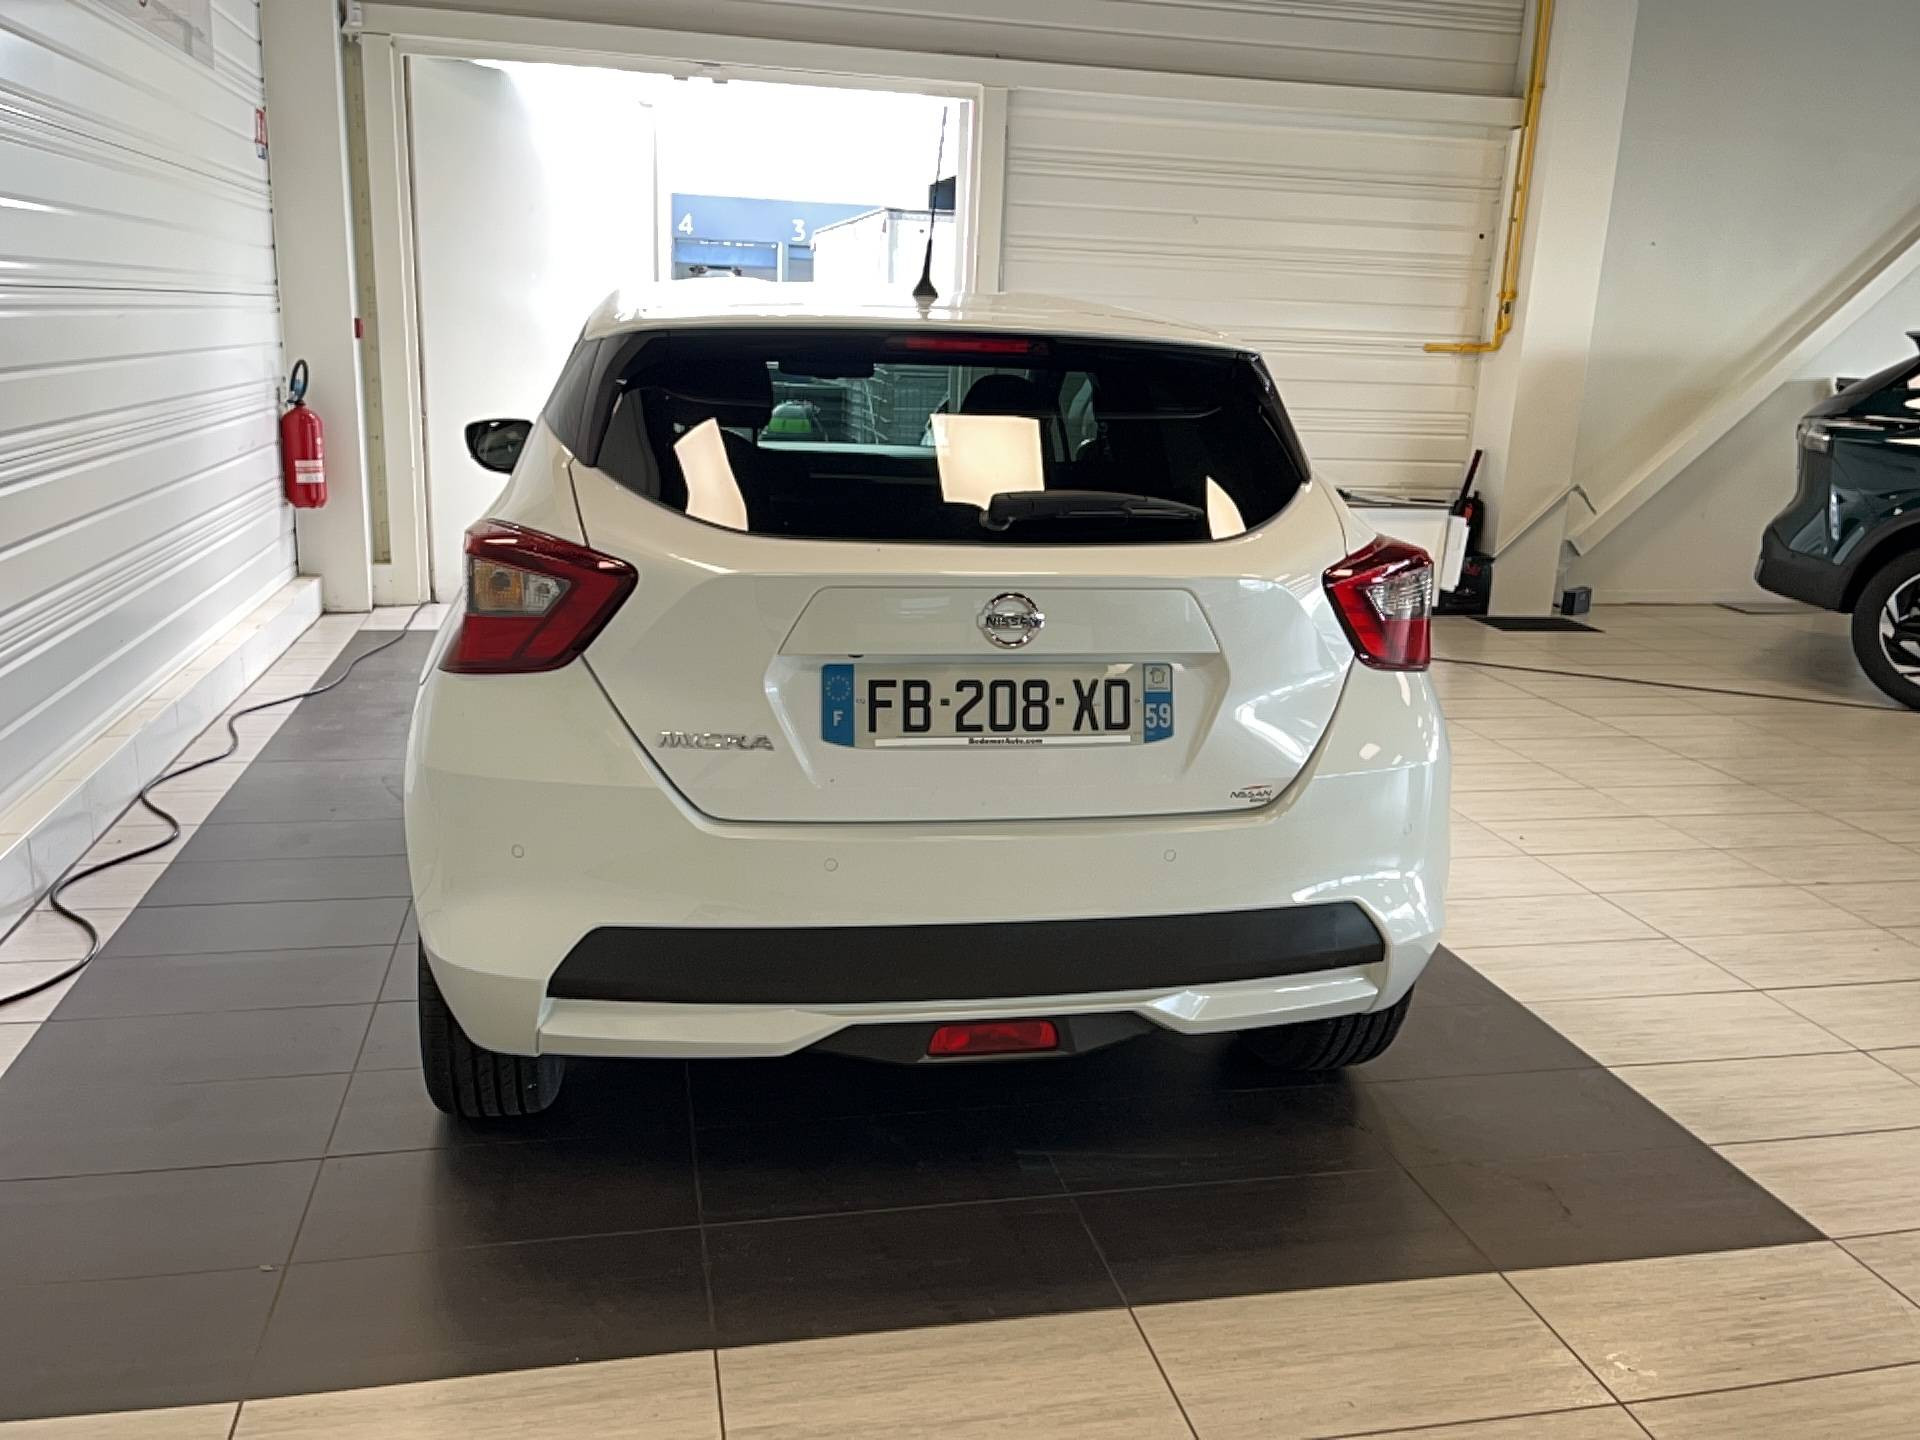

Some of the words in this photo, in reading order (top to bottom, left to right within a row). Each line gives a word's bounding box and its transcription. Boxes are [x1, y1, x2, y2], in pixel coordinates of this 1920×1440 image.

[678, 212, 694, 235] 4
[791, 218, 806, 241] 3
[868, 679, 1131, 733] FB-208-XD
[1145, 703, 1171, 728] 59
[832, 710, 845, 727] F
[658, 731, 775, 752] MICRA
